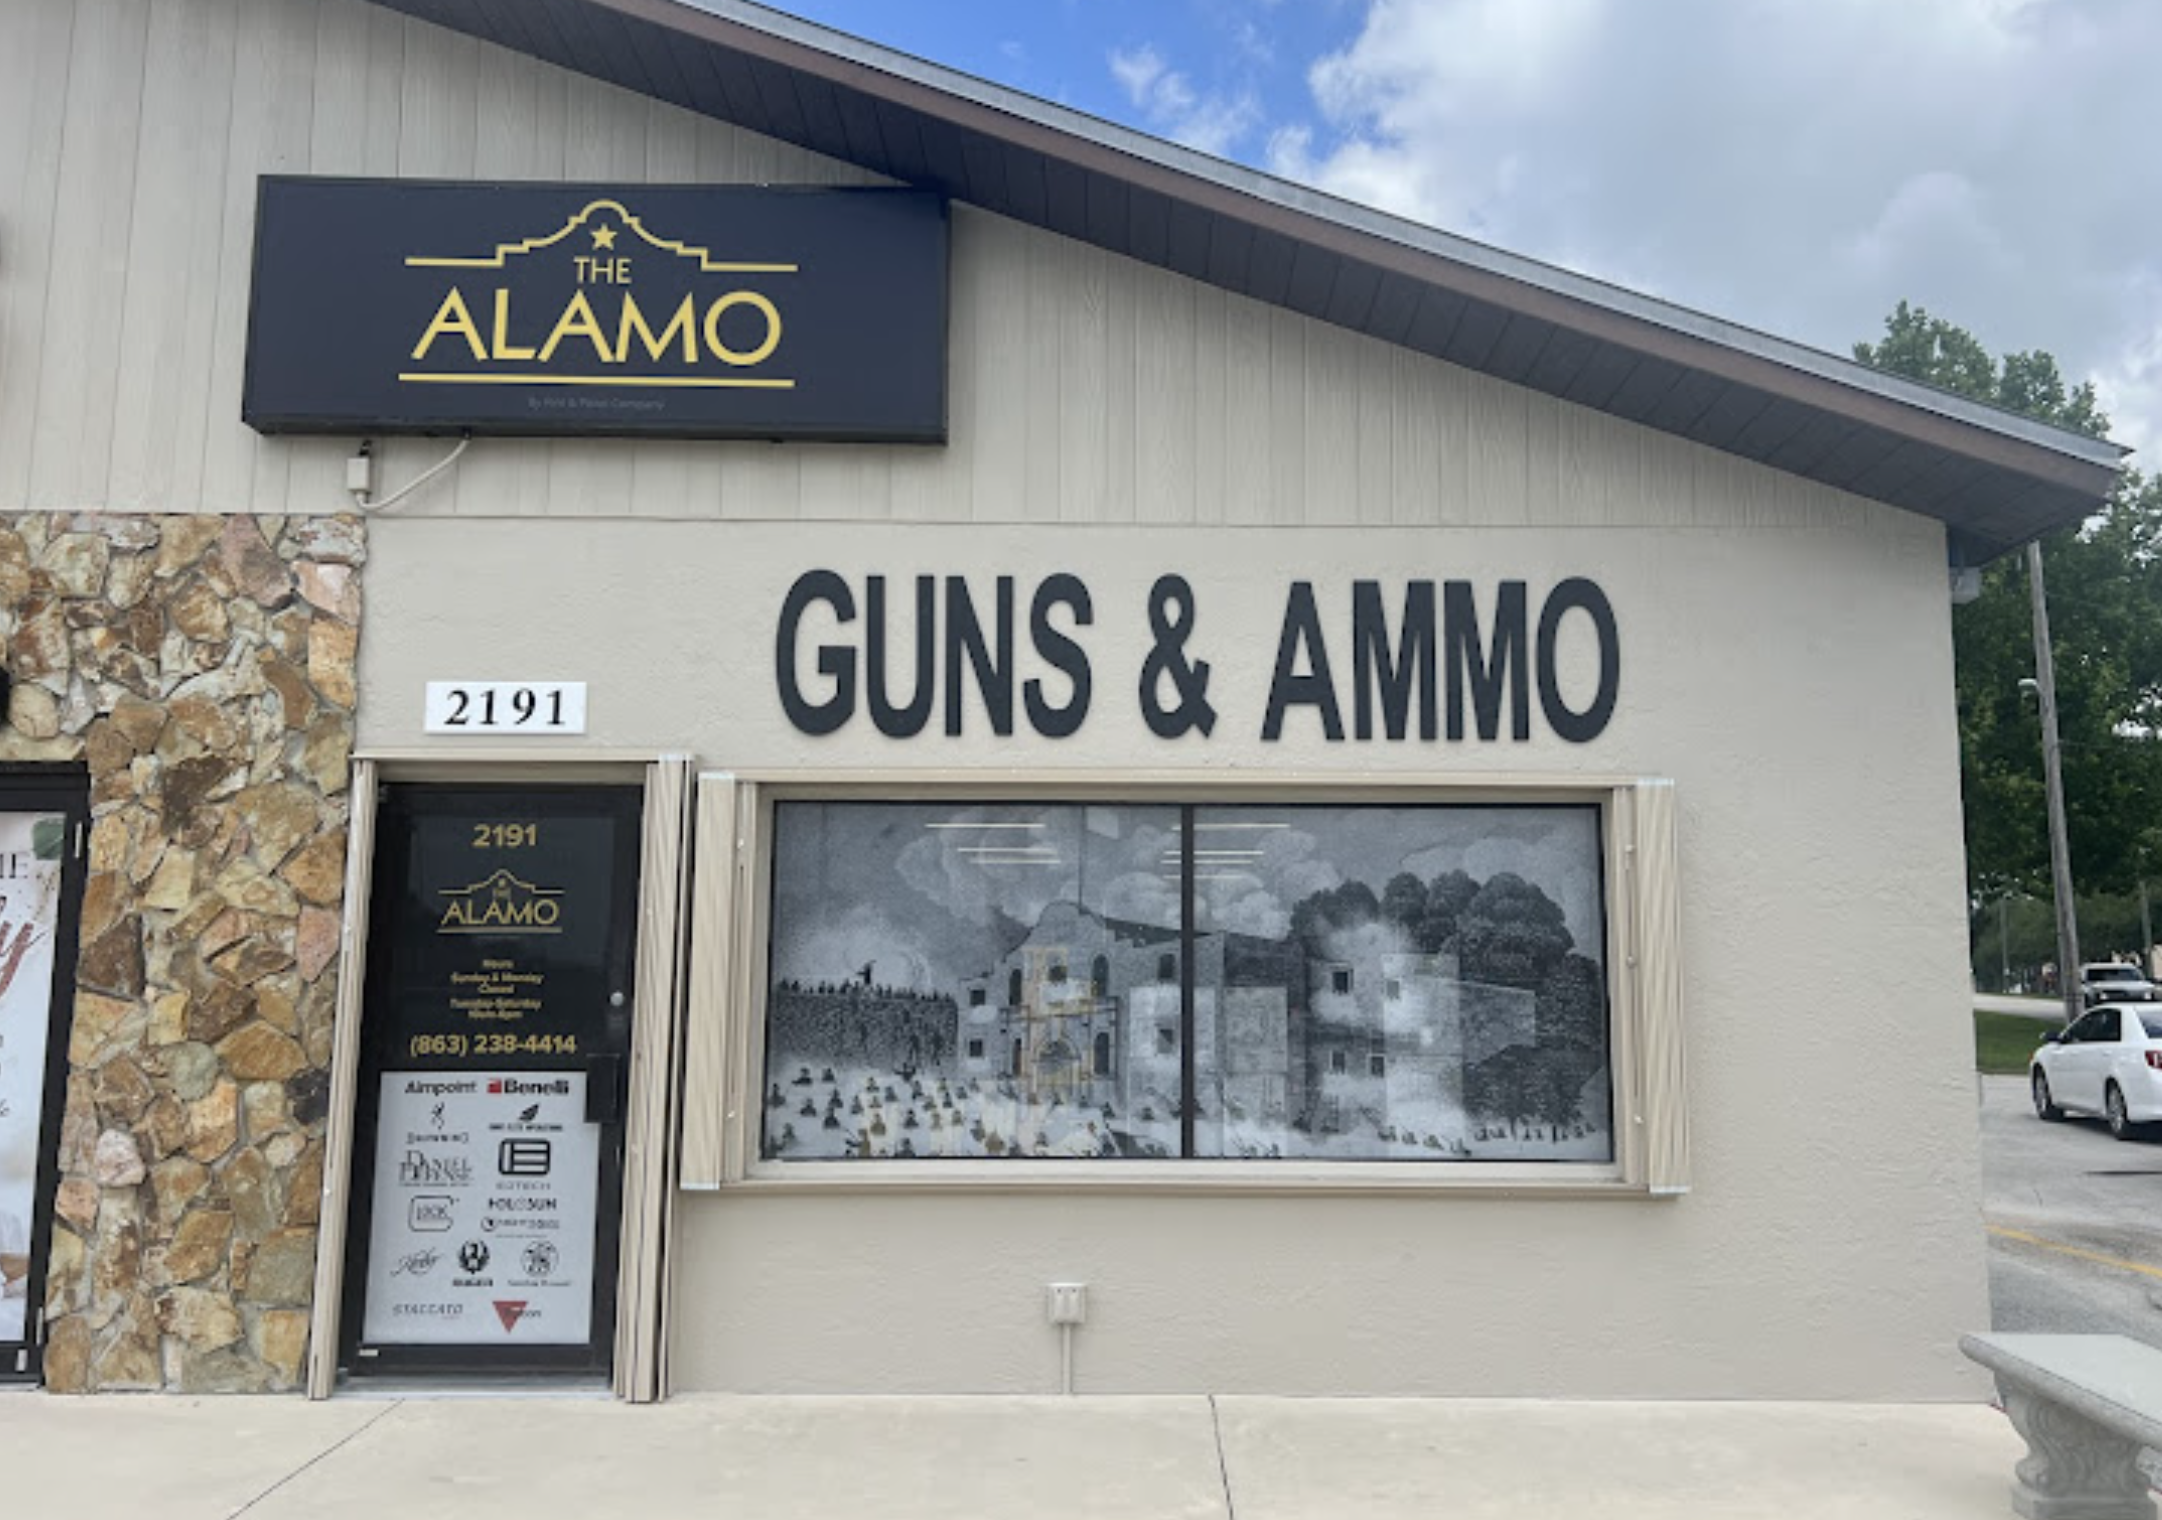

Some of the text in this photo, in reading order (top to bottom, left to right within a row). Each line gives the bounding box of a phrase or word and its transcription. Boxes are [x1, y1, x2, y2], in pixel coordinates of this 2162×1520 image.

[574, 256, 631, 285] THE
[411, 285, 782, 367] ALAMO
[775, 568, 1621, 744] GUNS & AMMO
[444, 688, 565, 726] 2191
[472, 824, 537, 847] 2191
[441, 898, 560, 926] ALAMO
[410, 1034, 577, 1057] (863) 238-4414
[405, 1080, 477, 1096] Aimpoint
[504, 1079, 569, 1095] Benelli
[488, 1197, 557, 1211] HOLOSUN
